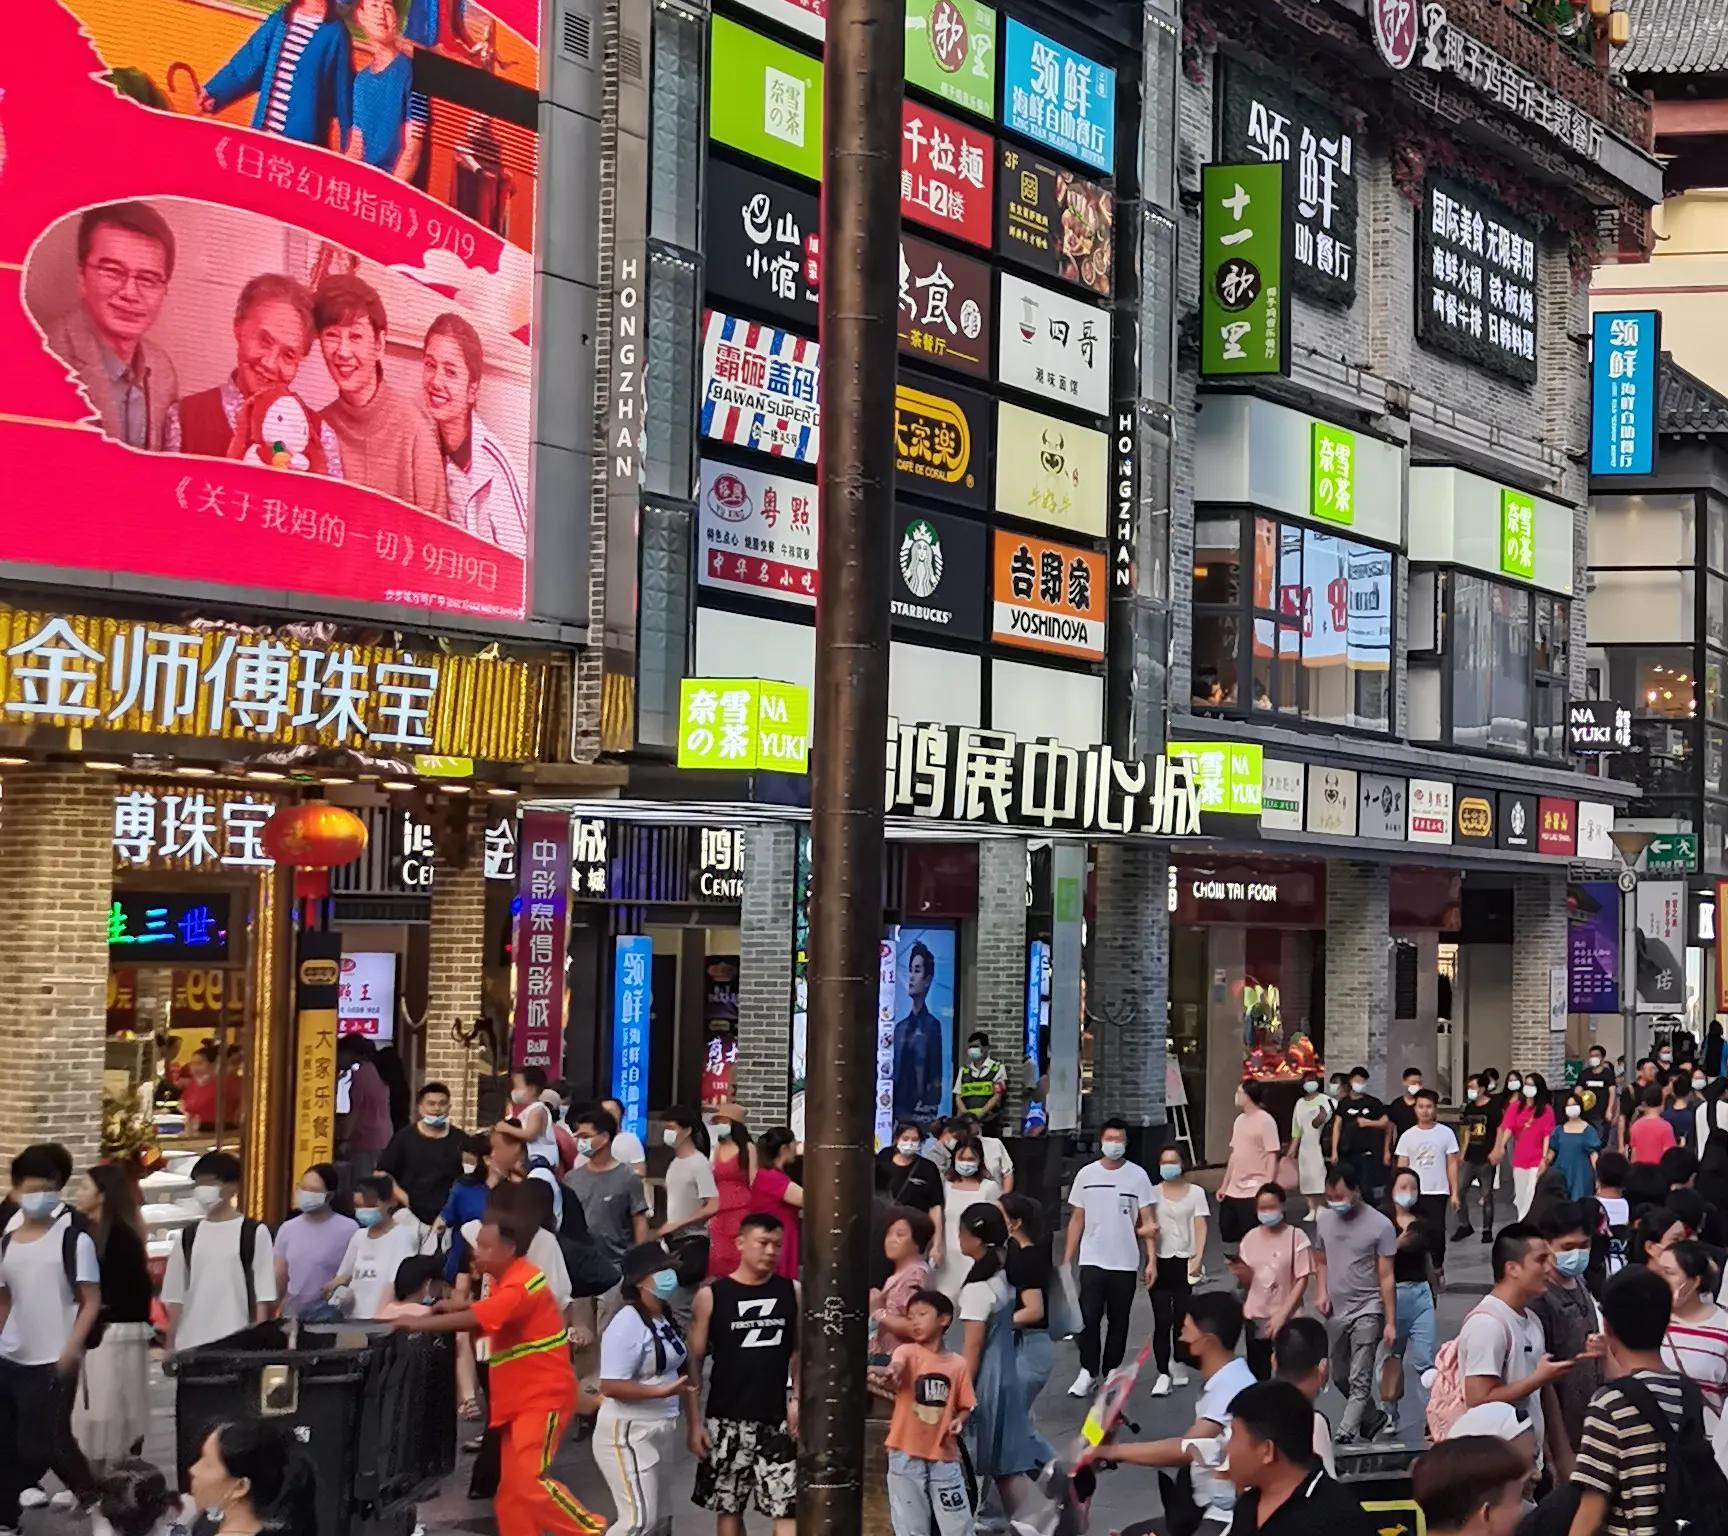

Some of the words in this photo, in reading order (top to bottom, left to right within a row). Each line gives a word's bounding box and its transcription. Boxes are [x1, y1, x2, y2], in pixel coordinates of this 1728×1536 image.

[1012, 84, 1106, 155] 海鲜自助餐厅
[212, 134, 420, 240] 《日常幻想指南》
[426, 212, 477, 261] 9/19
[1294, 221, 1352, 282] 助餐厅
[1431, 186, 1485, 260] 国际美食
[1487, 219, 1535, 283] 无限享用
[745, 247, 801, 300] 小馆
[1431, 245, 1484, 300] 海鲜火锅
[1487, 271, 1535, 325] 铁板烧
[909, 329, 947, 356] 茶餐厅
[1487, 311, 1535, 363] 日韩料理
[615, 258, 638, 479] HONGZHAN
[1115, 412, 1134, 587] HONGZHAN
[173, 476, 417, 569] 《关于我妈的一切》
[421, 541, 499, 593] 9月19日
[889, 600, 950, 625] STARBUCKS
[1010, 608, 1089, 645] YOSHINOYA
[3, 616, 440, 749] 金师傅珠宝
[686, 687, 752, 726] 奈雪
[759, 693, 789, 725] NA
[686, 723, 752, 761] の茶
[1570, 708, 1595, 724] NA
[1570, 726, 1610, 743] YUKI
[759, 732, 808, 764] YUKI
[885, 714, 1202, 835] 鸿展中心城
[1192, 880, 1226, 902] CHOW
[1226, 882, 1245, 902] TAI
[525, 836, 559, 1029] 中影泰得影城
